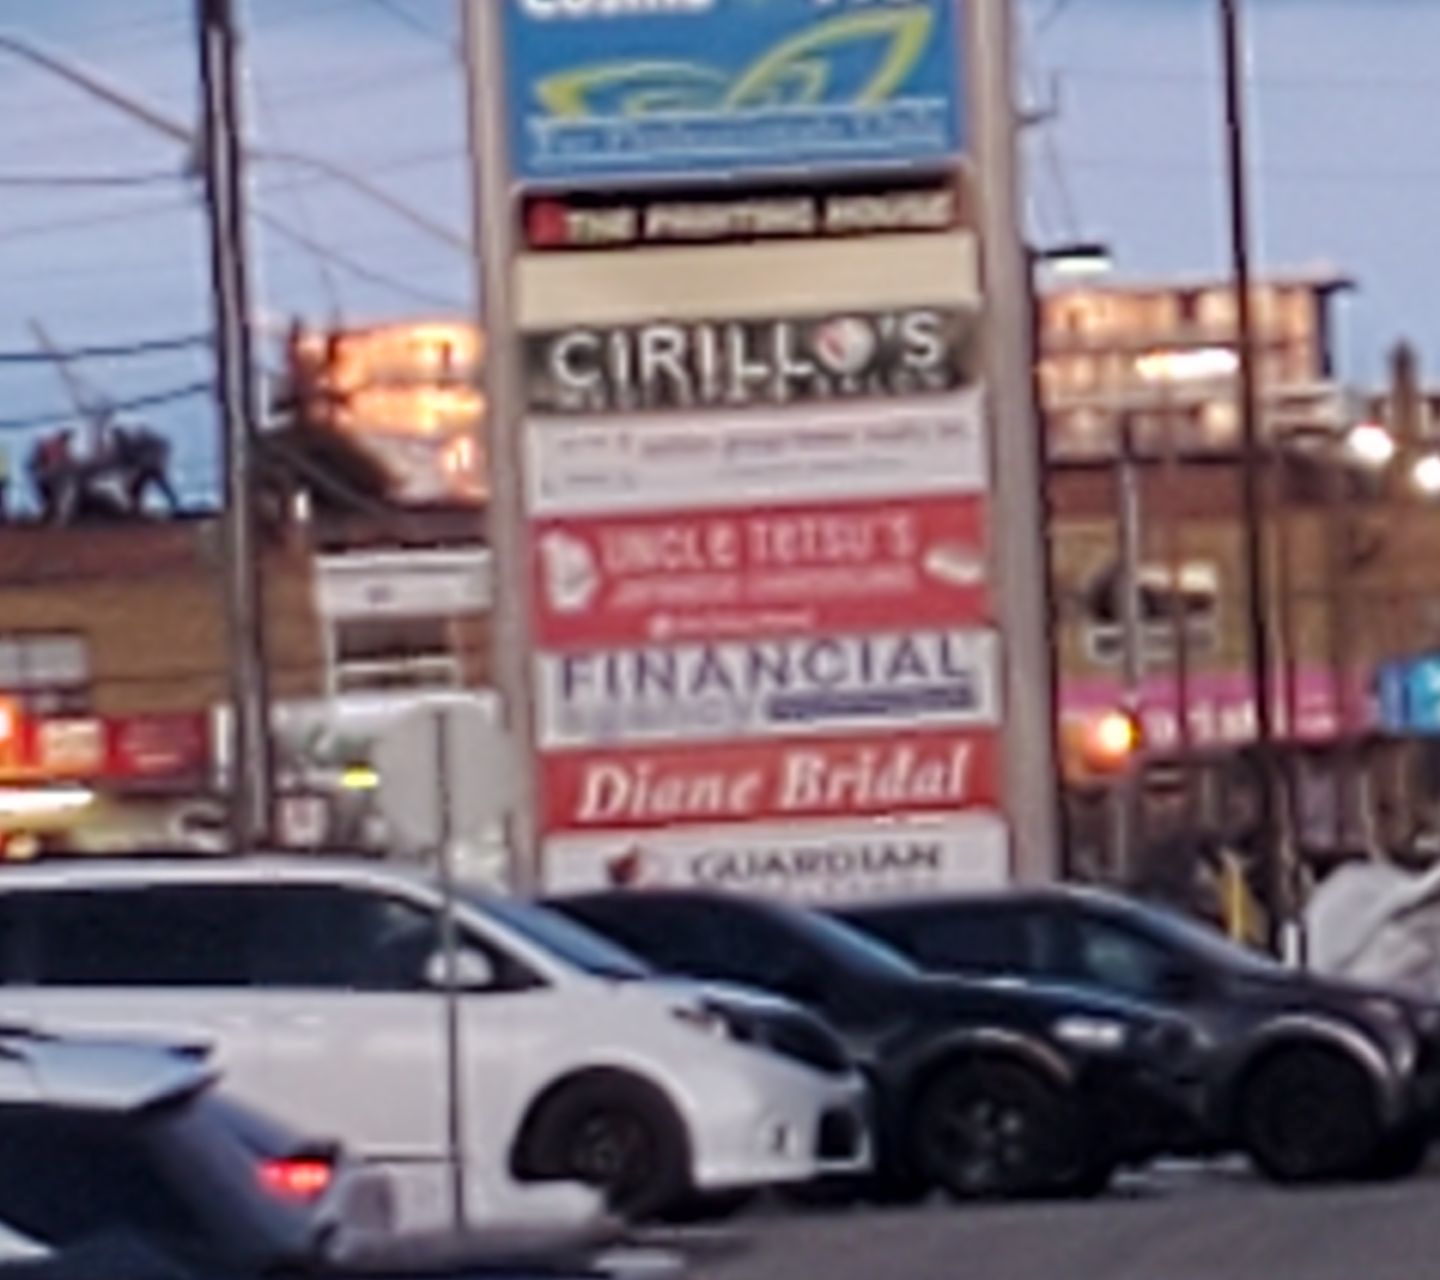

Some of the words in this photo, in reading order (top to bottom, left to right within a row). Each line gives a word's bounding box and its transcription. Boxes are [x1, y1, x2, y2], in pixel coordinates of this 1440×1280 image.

[551, 310, 945, 387] CIRILLO'S
[560, 636, 970, 699] FINANCIAL
[577, 760, 763, 821] Diane
[778, 744, 973, 812] Bridal
[690, 838, 941, 880] GUARDIAN
